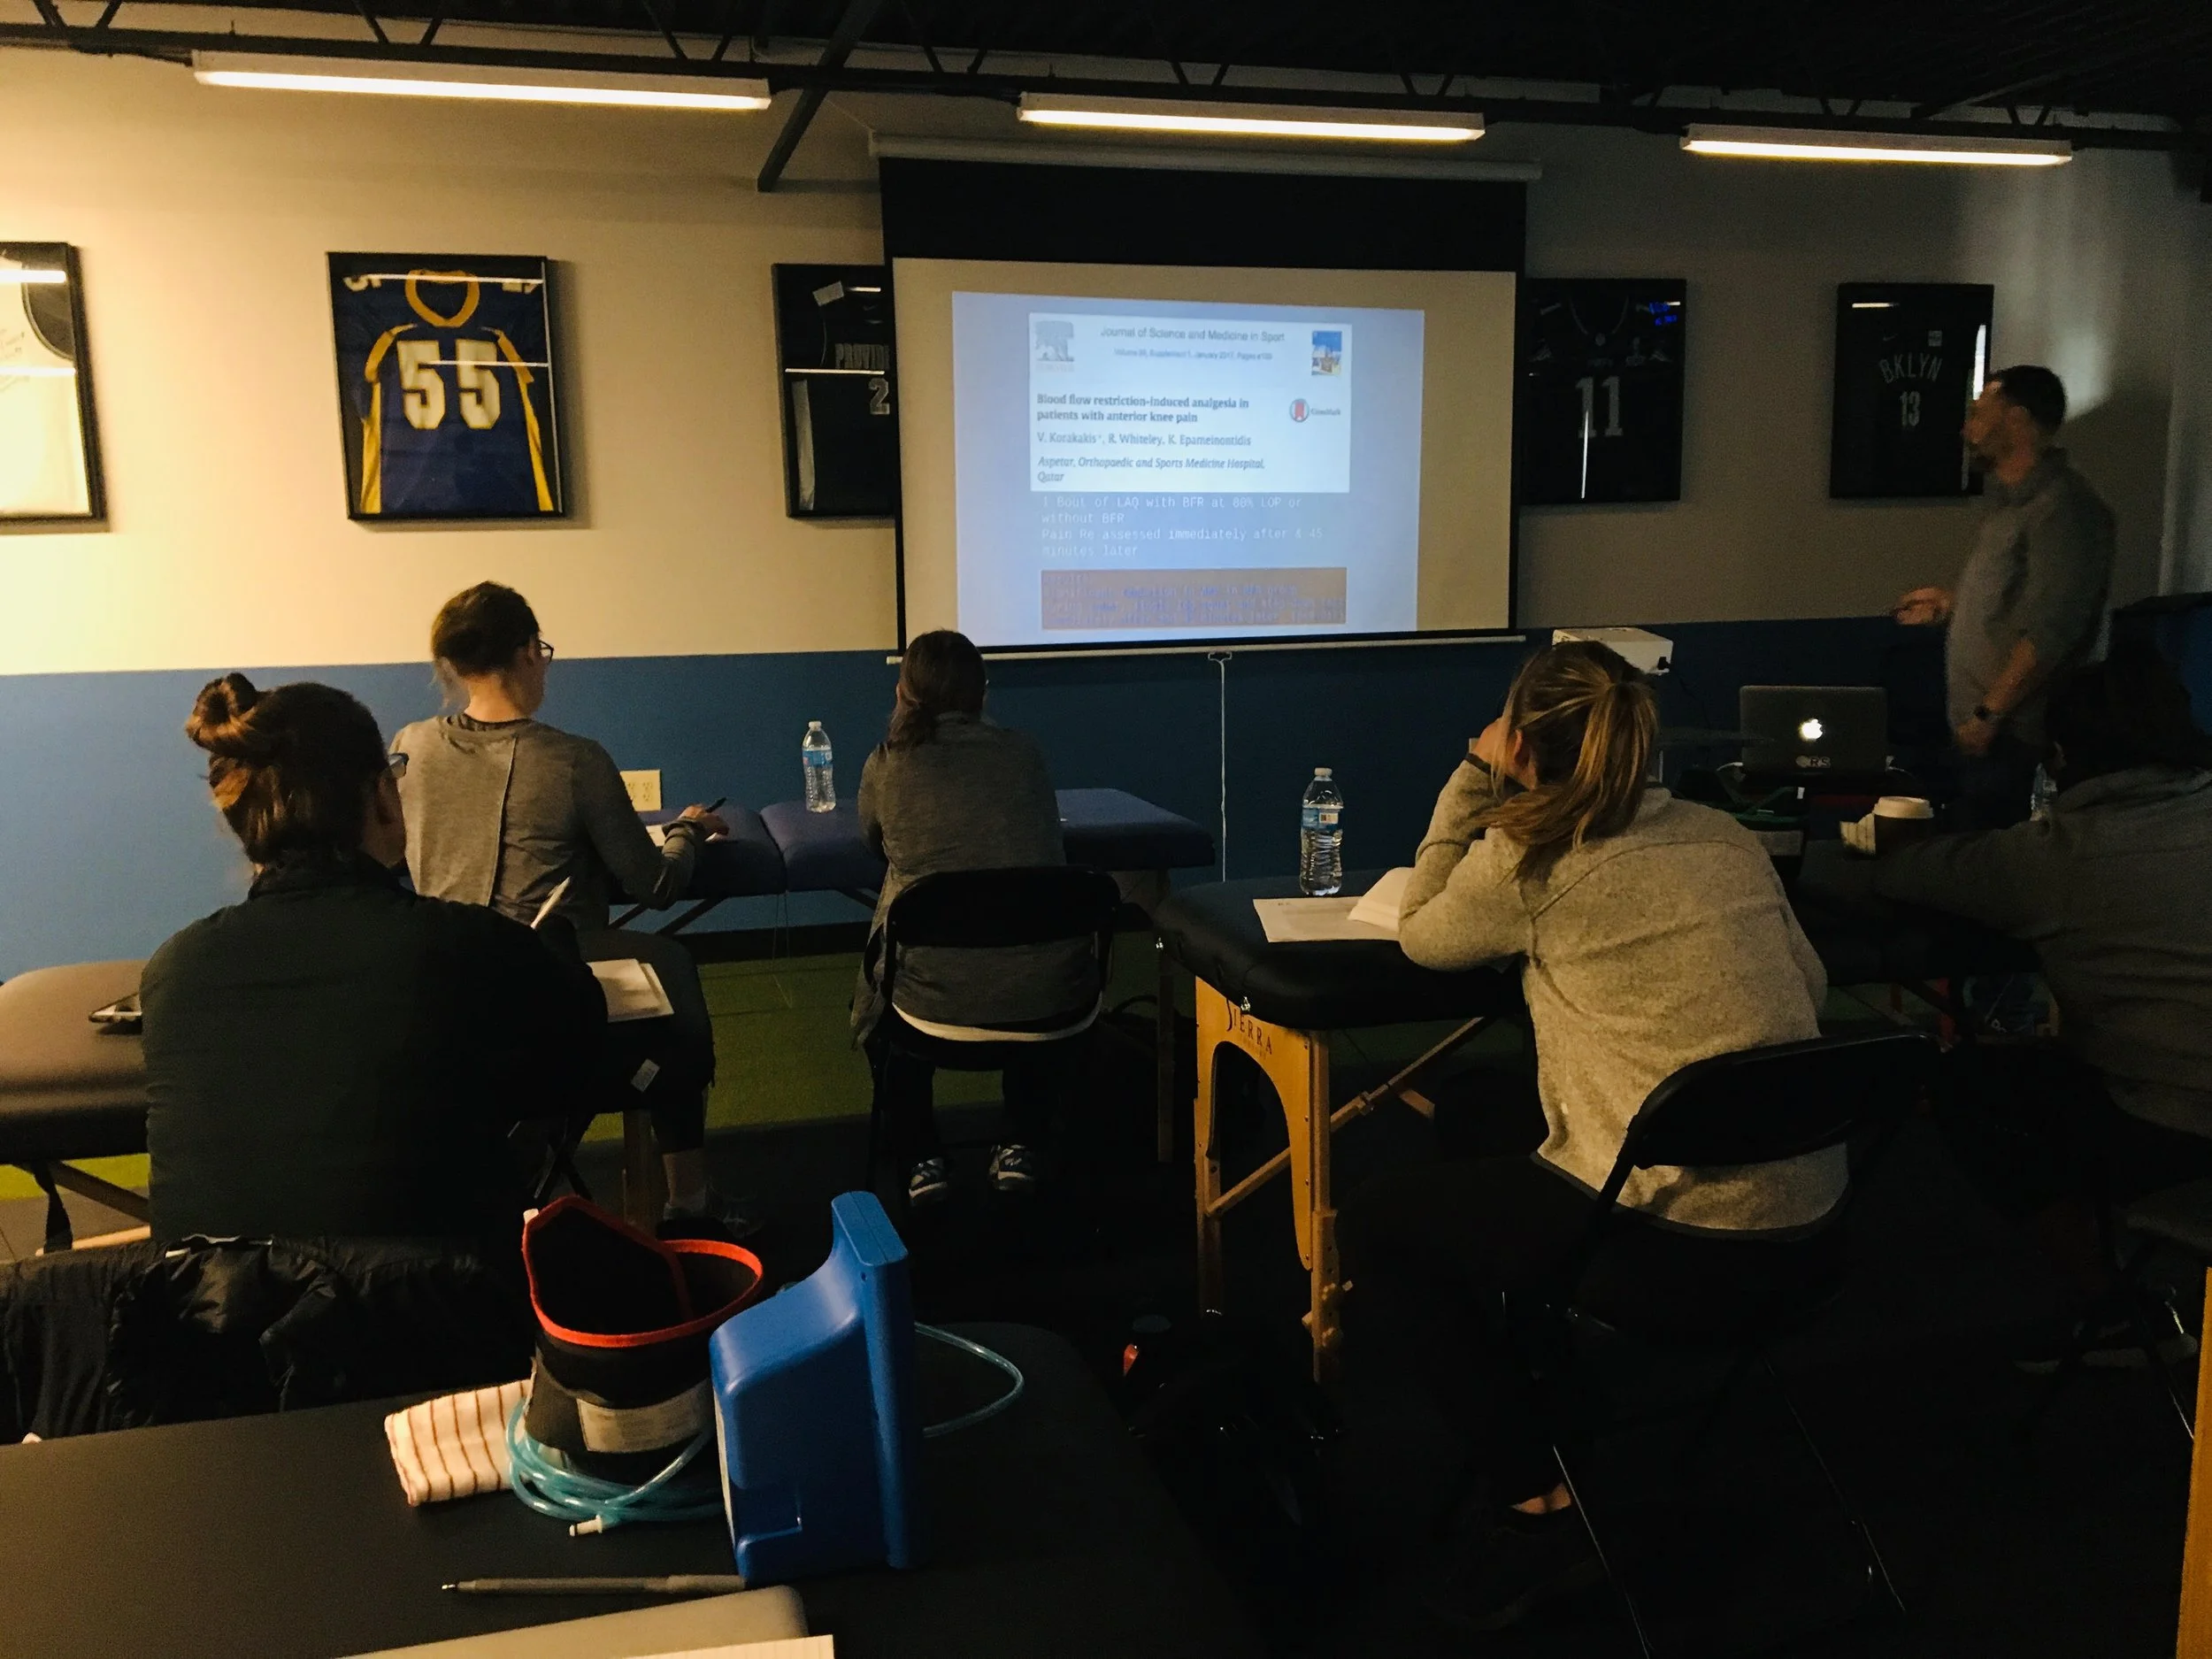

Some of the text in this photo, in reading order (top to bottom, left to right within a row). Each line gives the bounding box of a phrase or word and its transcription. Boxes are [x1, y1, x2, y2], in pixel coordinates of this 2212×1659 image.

[1101, 326, 1286, 344] Journal of Science and Medicine in Sport
[1879, 352, 1943, 384] BKLYN
[396, 338, 502, 430] 55
[1037, 394, 1249, 411] Blood flow restriction-induced analgesia in
[1575, 375, 1624, 438] 11
[1900, 390, 1922, 427] 13
[1037, 410, 1198, 424] patients with anterior knee pain
[1078, 457, 1133, 470] Orthopaedic
[1135, 457, 1153, 468] and
[1155, 457, 1183, 470] Sports
[1185, 458, 1225, 469] Medicine
[1037, 472, 1064, 483] Qatar
[1056, 495, 1086, 508] Bout
[1094, 495, 1109, 508] of
[1117, 496, 1140, 510] LAQ
[1146, 495, 1176, 508] with
[1182, 496, 1204, 508] BFR
[1211, 496, 1225, 508] at
[1261, 496, 1281, 509] LOP
[1041, 511, 1125, 524] without BFR
[1041, 527, 1072, 540] Pain
[1102, 528, 1161, 540] assessed
[1168, 528, 1247, 541] immediately
[1253, 527, 1286, 540] after
[1042, 545, 1139, 557] minutes later
